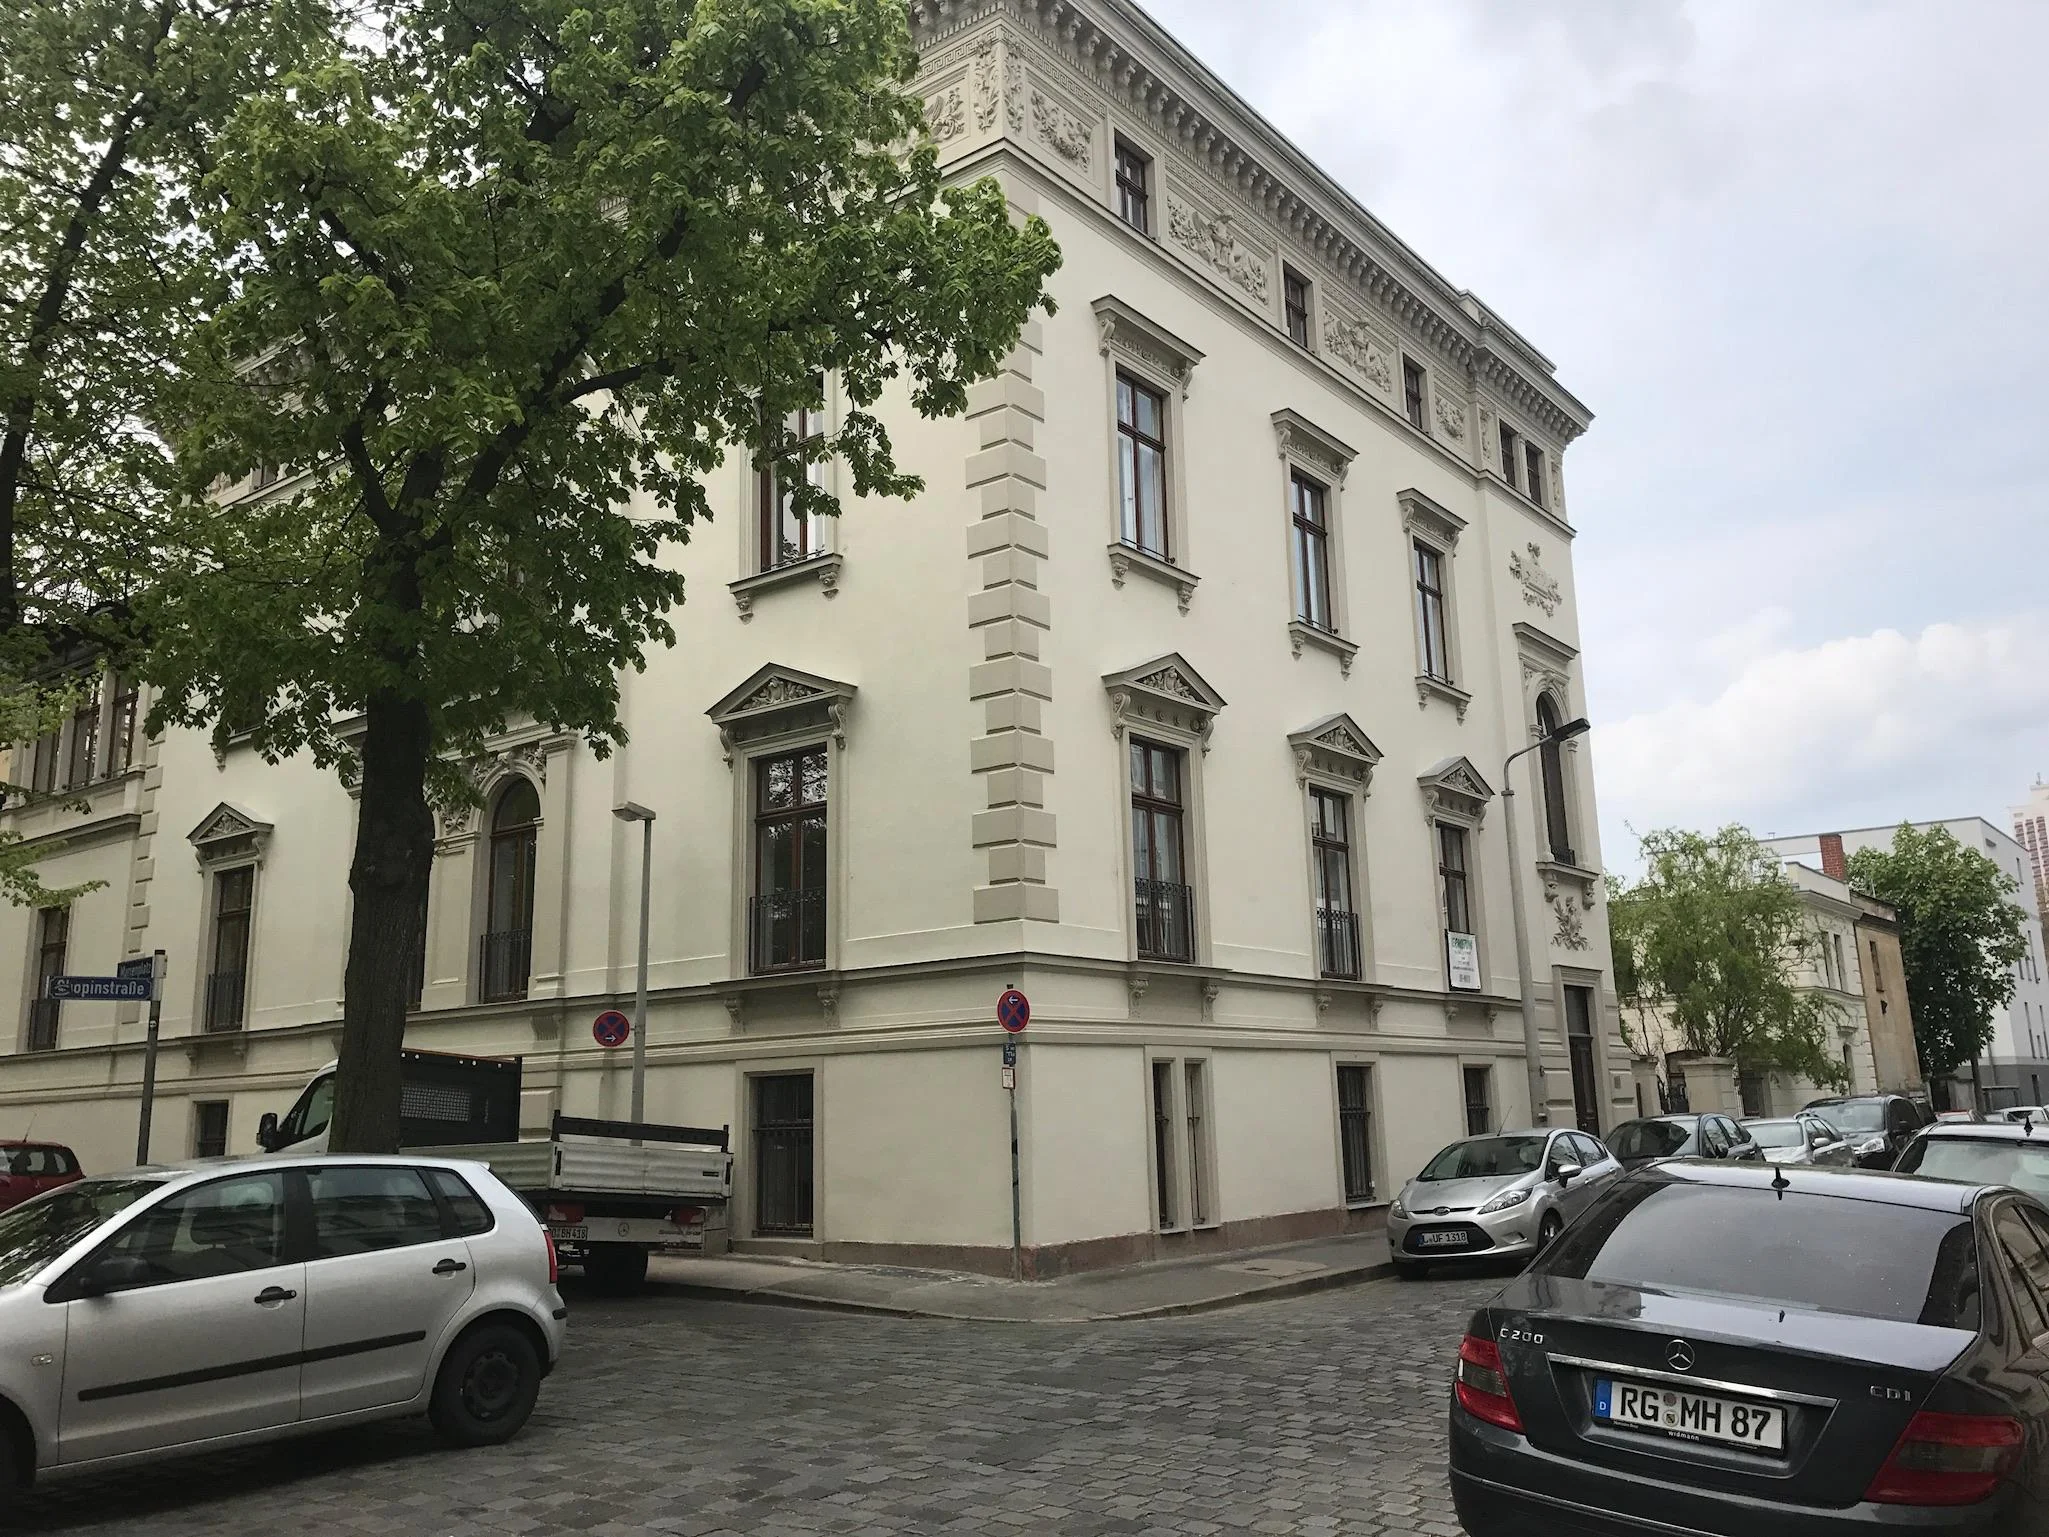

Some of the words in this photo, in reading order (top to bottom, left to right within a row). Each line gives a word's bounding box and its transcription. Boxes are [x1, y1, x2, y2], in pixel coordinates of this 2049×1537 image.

[1432, 1233, 1443, 1243] UF
[1445, 1232, 1466, 1242] 1318
[1870, 1386, 1911, 1401] CDI
[1600, 1402, 1607, 1411] D
[1620, 1387, 1659, 1422] RG
[1680, 1396, 1722, 1433] MH
[1731, 1405, 1771, 1441] 87
[1668, 1431, 1700, 1441] widmann
